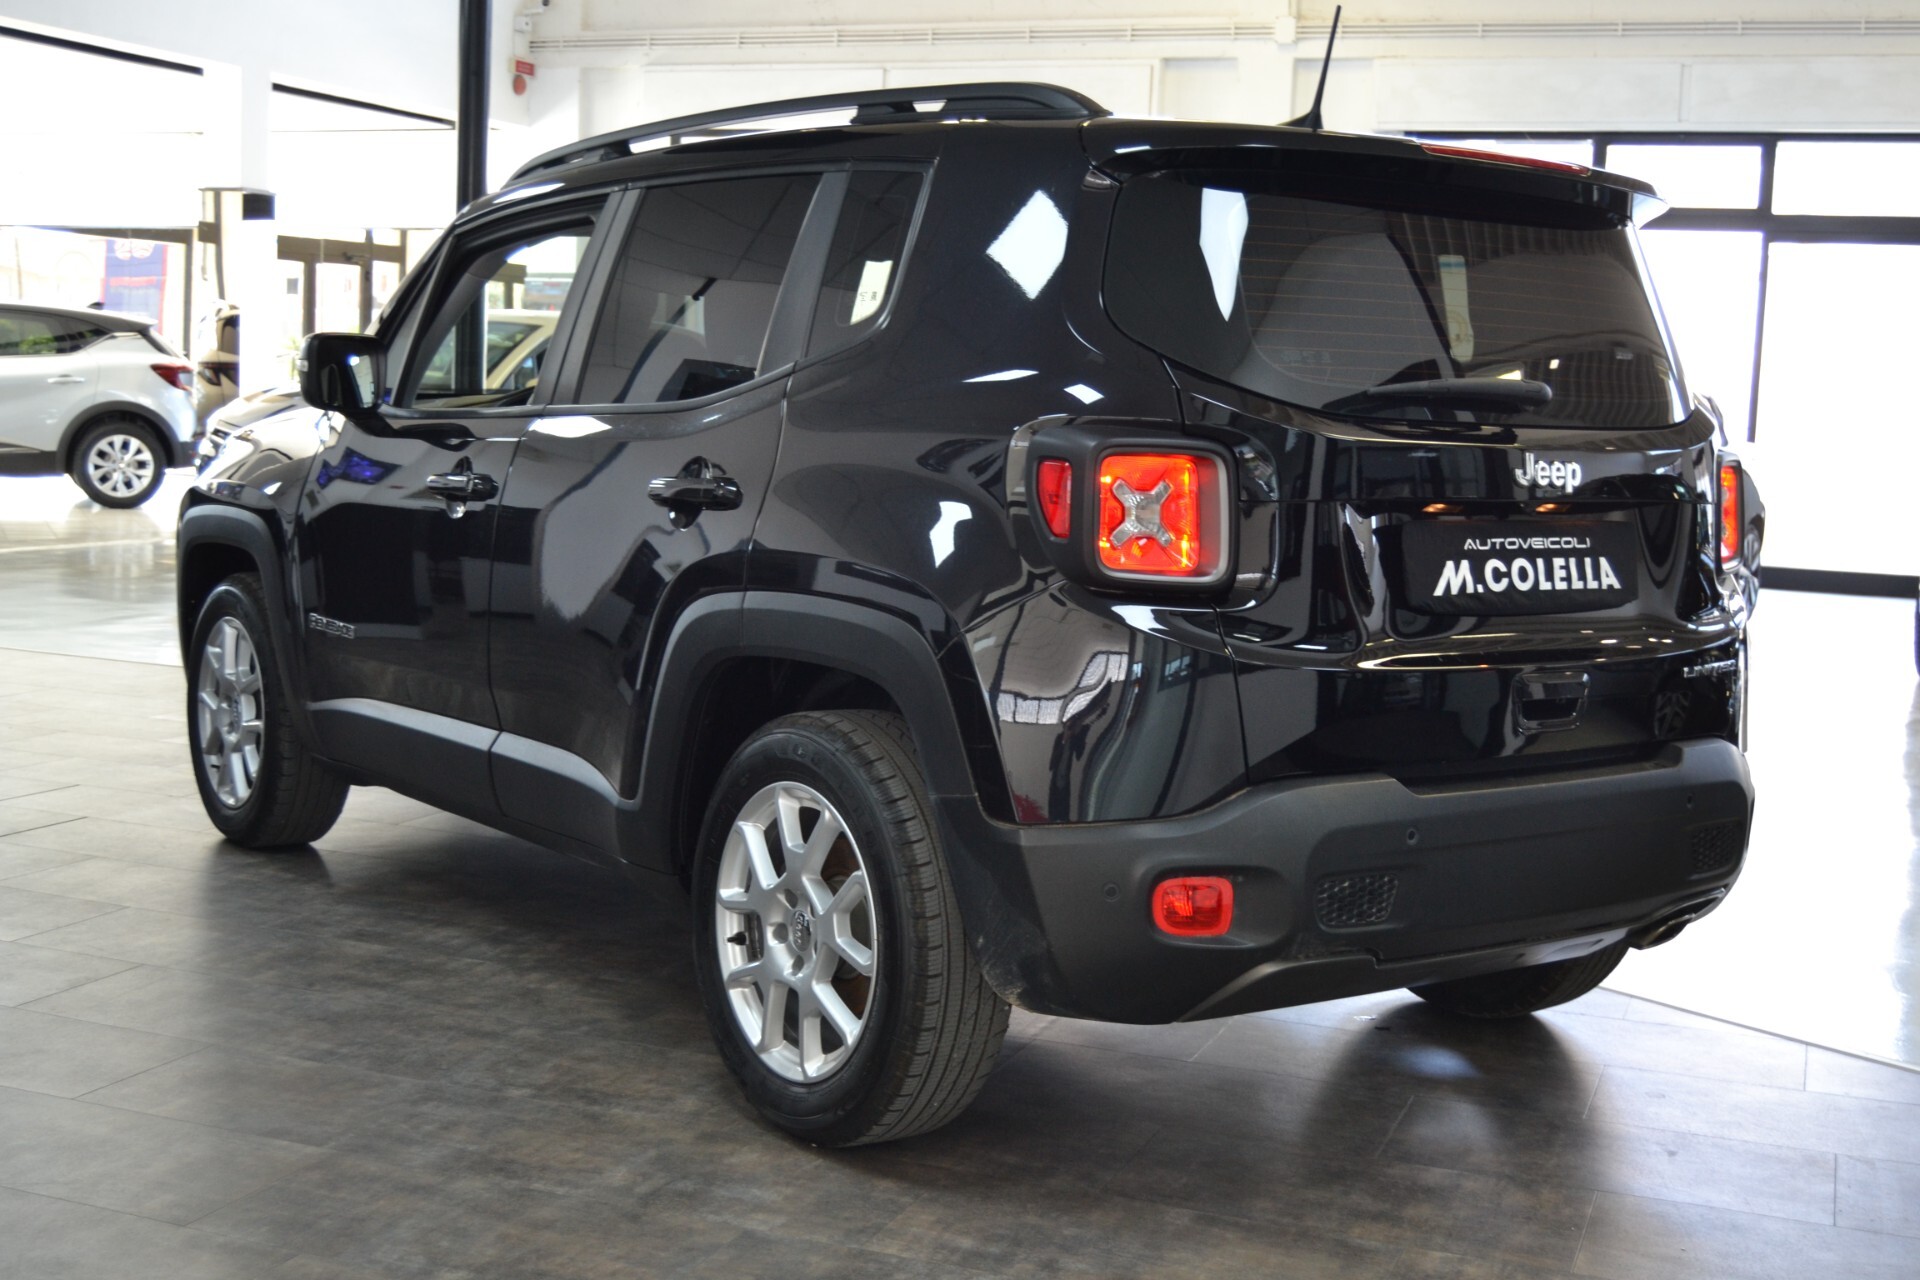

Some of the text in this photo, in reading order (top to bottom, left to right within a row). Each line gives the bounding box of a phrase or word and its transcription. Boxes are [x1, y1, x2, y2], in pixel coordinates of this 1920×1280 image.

[1514, 452, 1582, 493] Jeep
[1464, 537, 1591, 550] AUTOVEICOLI
[1433, 556, 1622, 597] M.COLELLA
